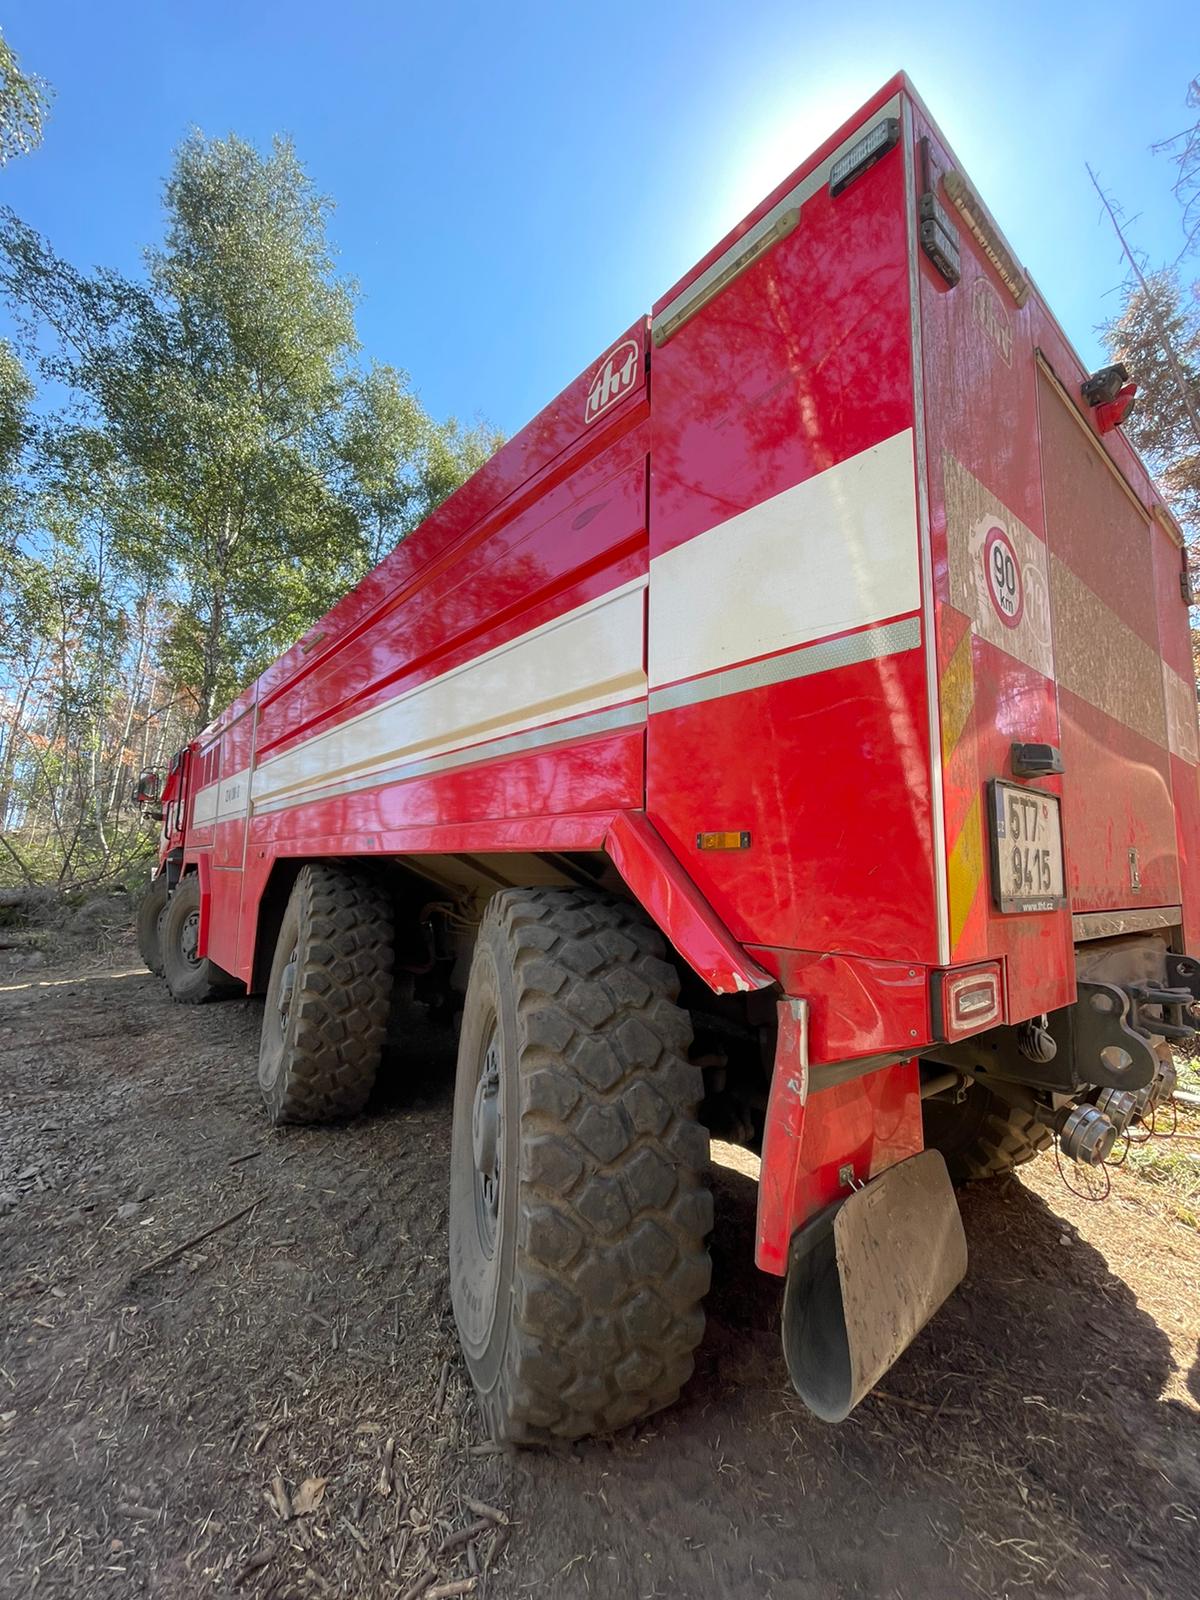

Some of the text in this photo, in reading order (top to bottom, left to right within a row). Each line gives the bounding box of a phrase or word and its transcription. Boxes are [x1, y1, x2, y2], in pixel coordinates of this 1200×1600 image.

[994, 546, 1015, 596] 90
[1000, 588, 1014, 615] km
[1008, 795, 1038, 842] 5T7
[1013, 846, 1051, 890] 9415
